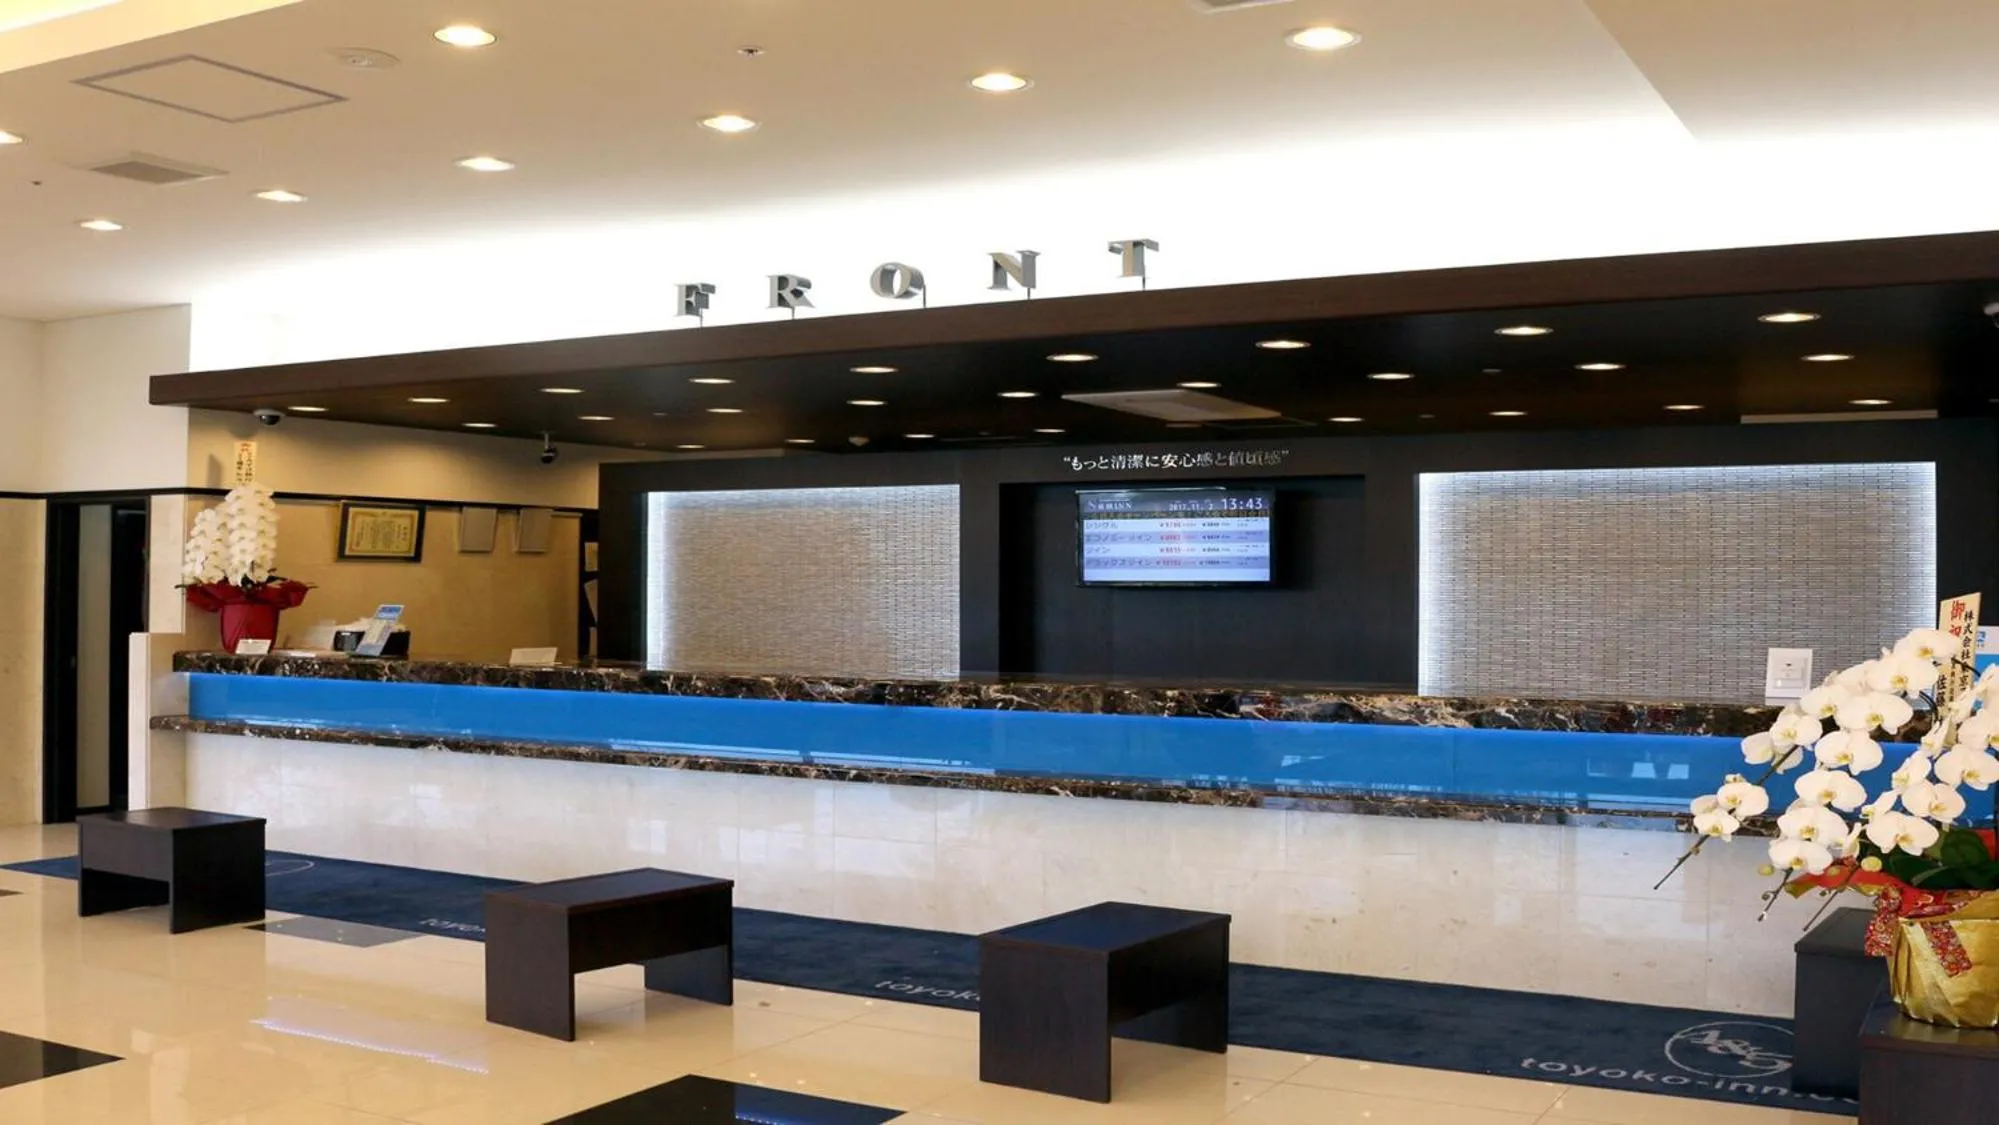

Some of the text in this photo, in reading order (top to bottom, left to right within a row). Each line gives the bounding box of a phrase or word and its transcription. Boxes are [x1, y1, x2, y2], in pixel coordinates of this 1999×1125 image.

[675, 238, 1160, 317] FRONT
[1221, 498, 1263, 510] 13:43
[1519, 1057, 1860, 1105] toyoko-inn.
